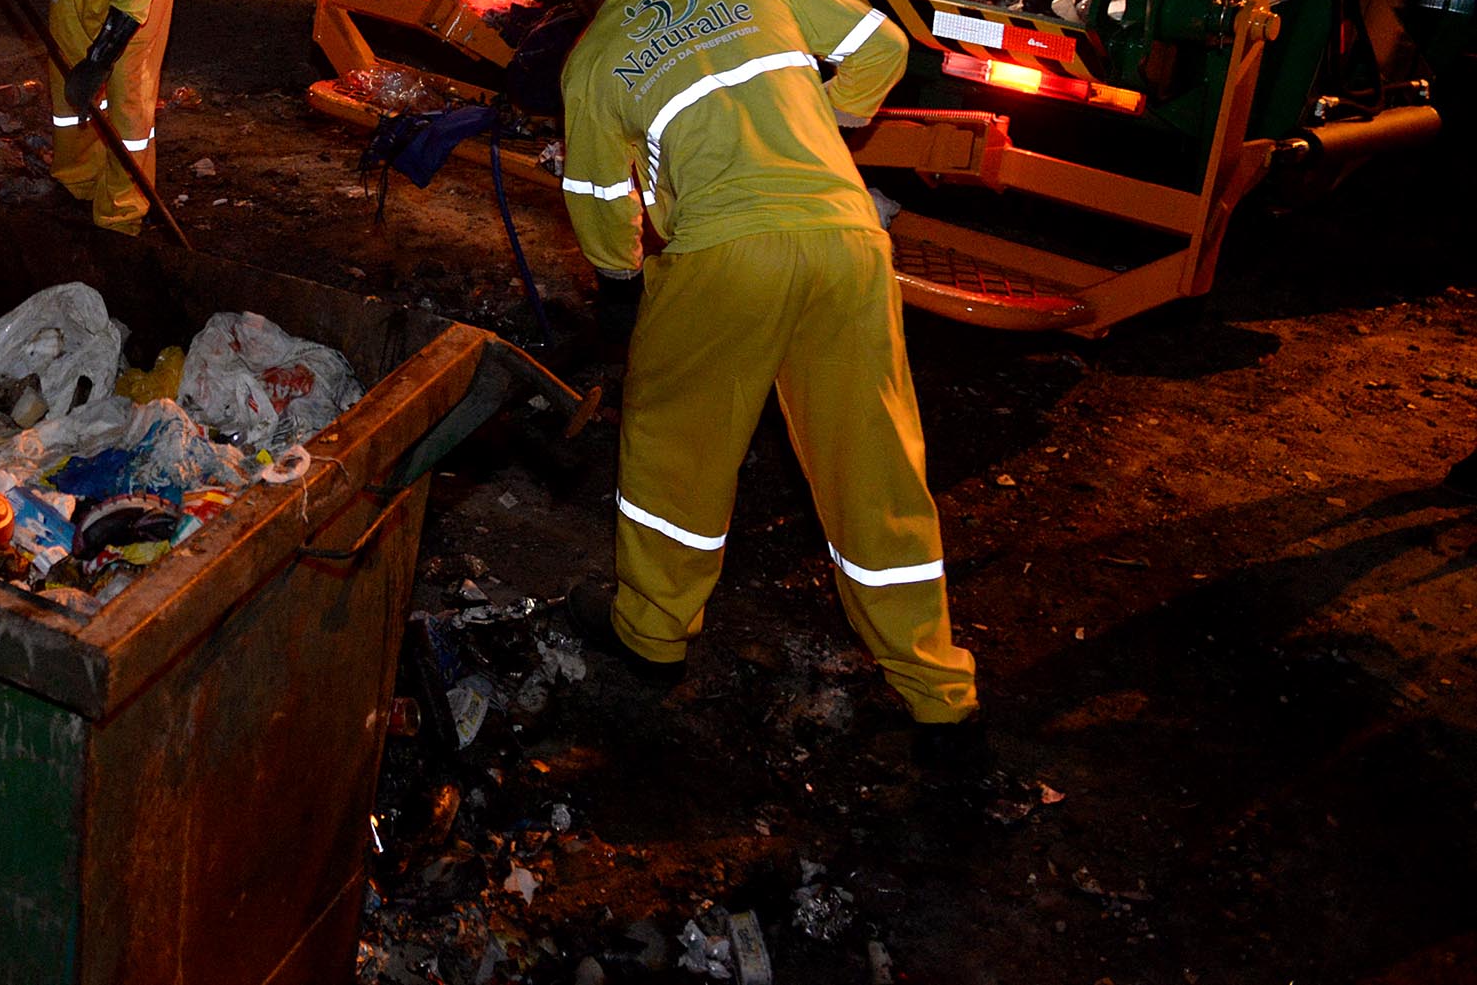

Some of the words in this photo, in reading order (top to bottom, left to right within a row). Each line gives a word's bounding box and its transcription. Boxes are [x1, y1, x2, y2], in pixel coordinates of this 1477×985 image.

[612, 0, 754, 91] Naturalle
[634, 93, 642, 103] A
[640, 58, 676, 95] SERVIÇO
[677, 48, 694, 61] DA
[694, 26, 760, 52] PREFEITURA
